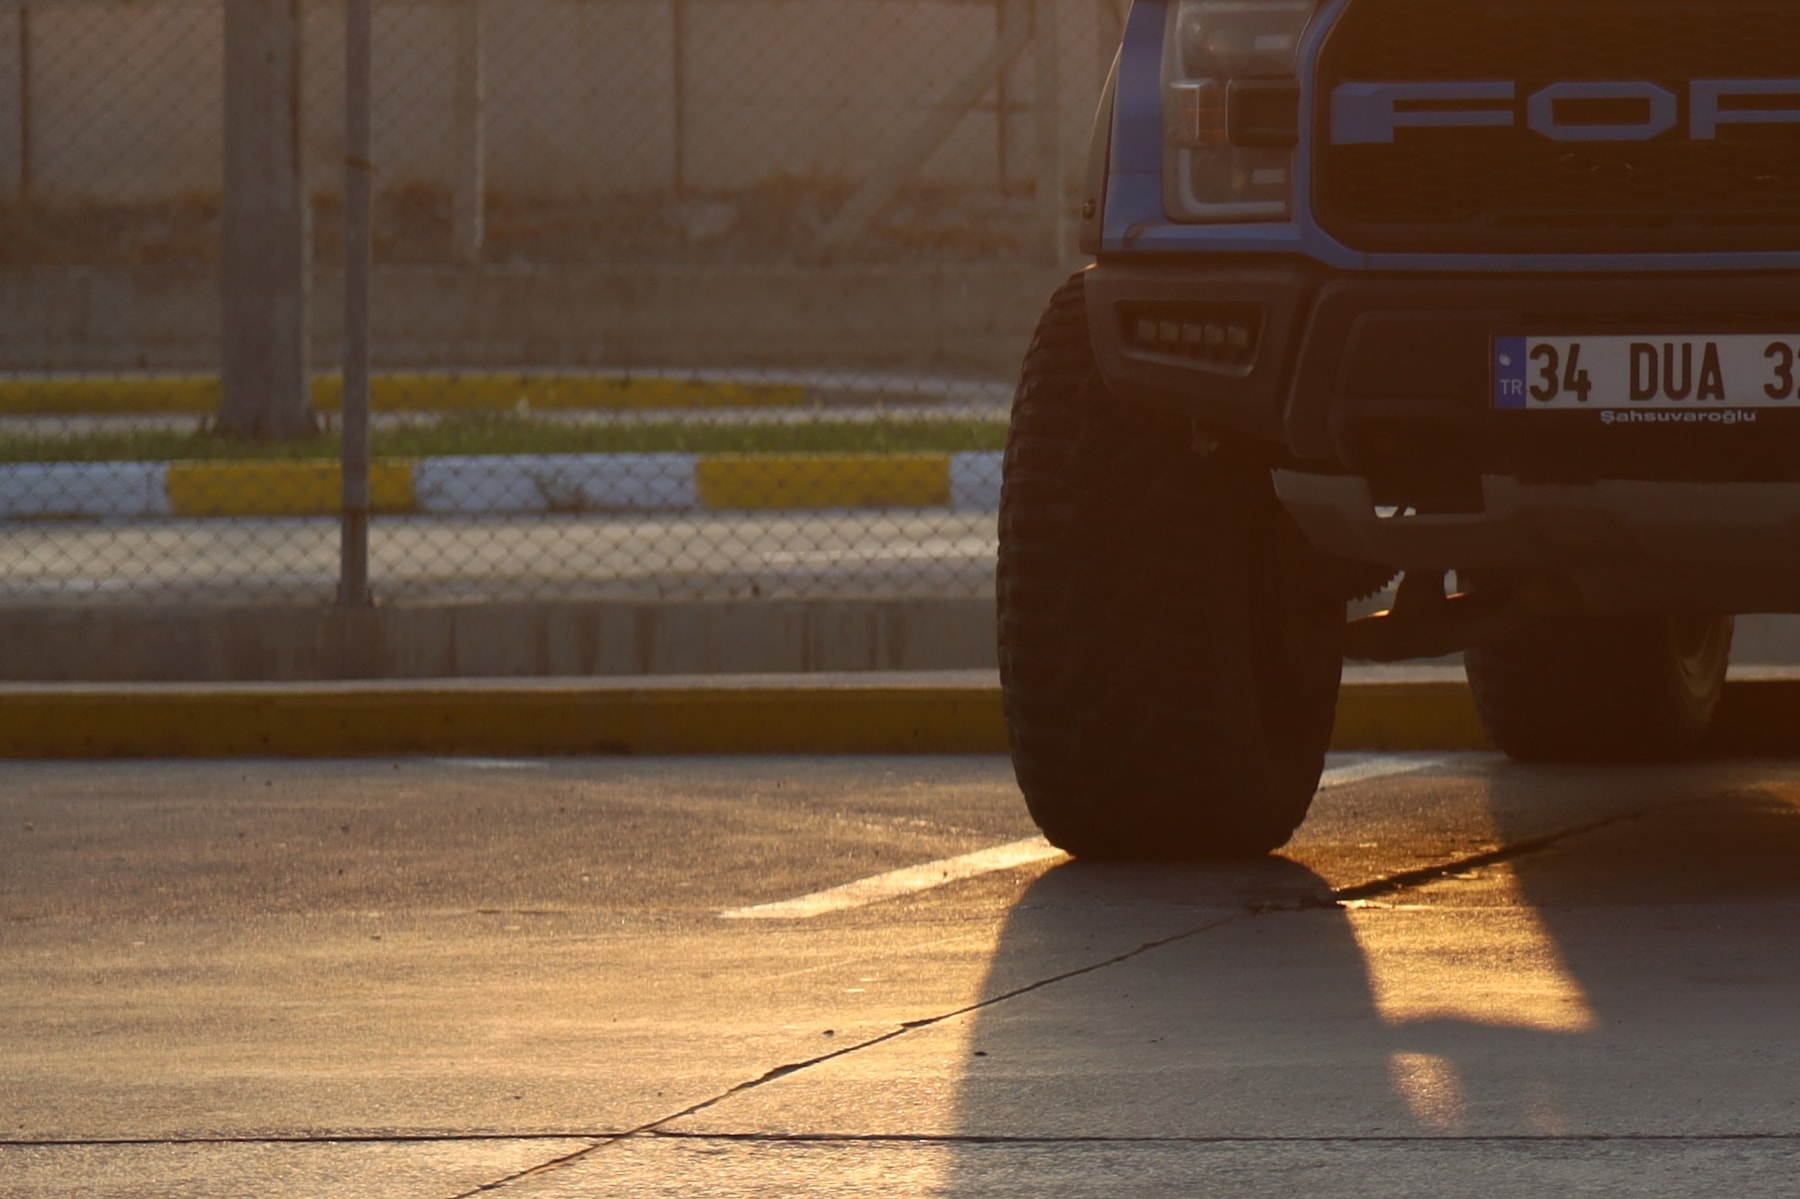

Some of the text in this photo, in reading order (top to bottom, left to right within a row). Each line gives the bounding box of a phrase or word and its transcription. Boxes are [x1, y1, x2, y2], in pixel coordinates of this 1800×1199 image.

[1529, 343, 1592, 402] 34
[1629, 341, 1726, 401] DUA
[1499, 378, 1523, 395] TR
[1600, 409, 1757, 425] Şahsuvaroğlu
